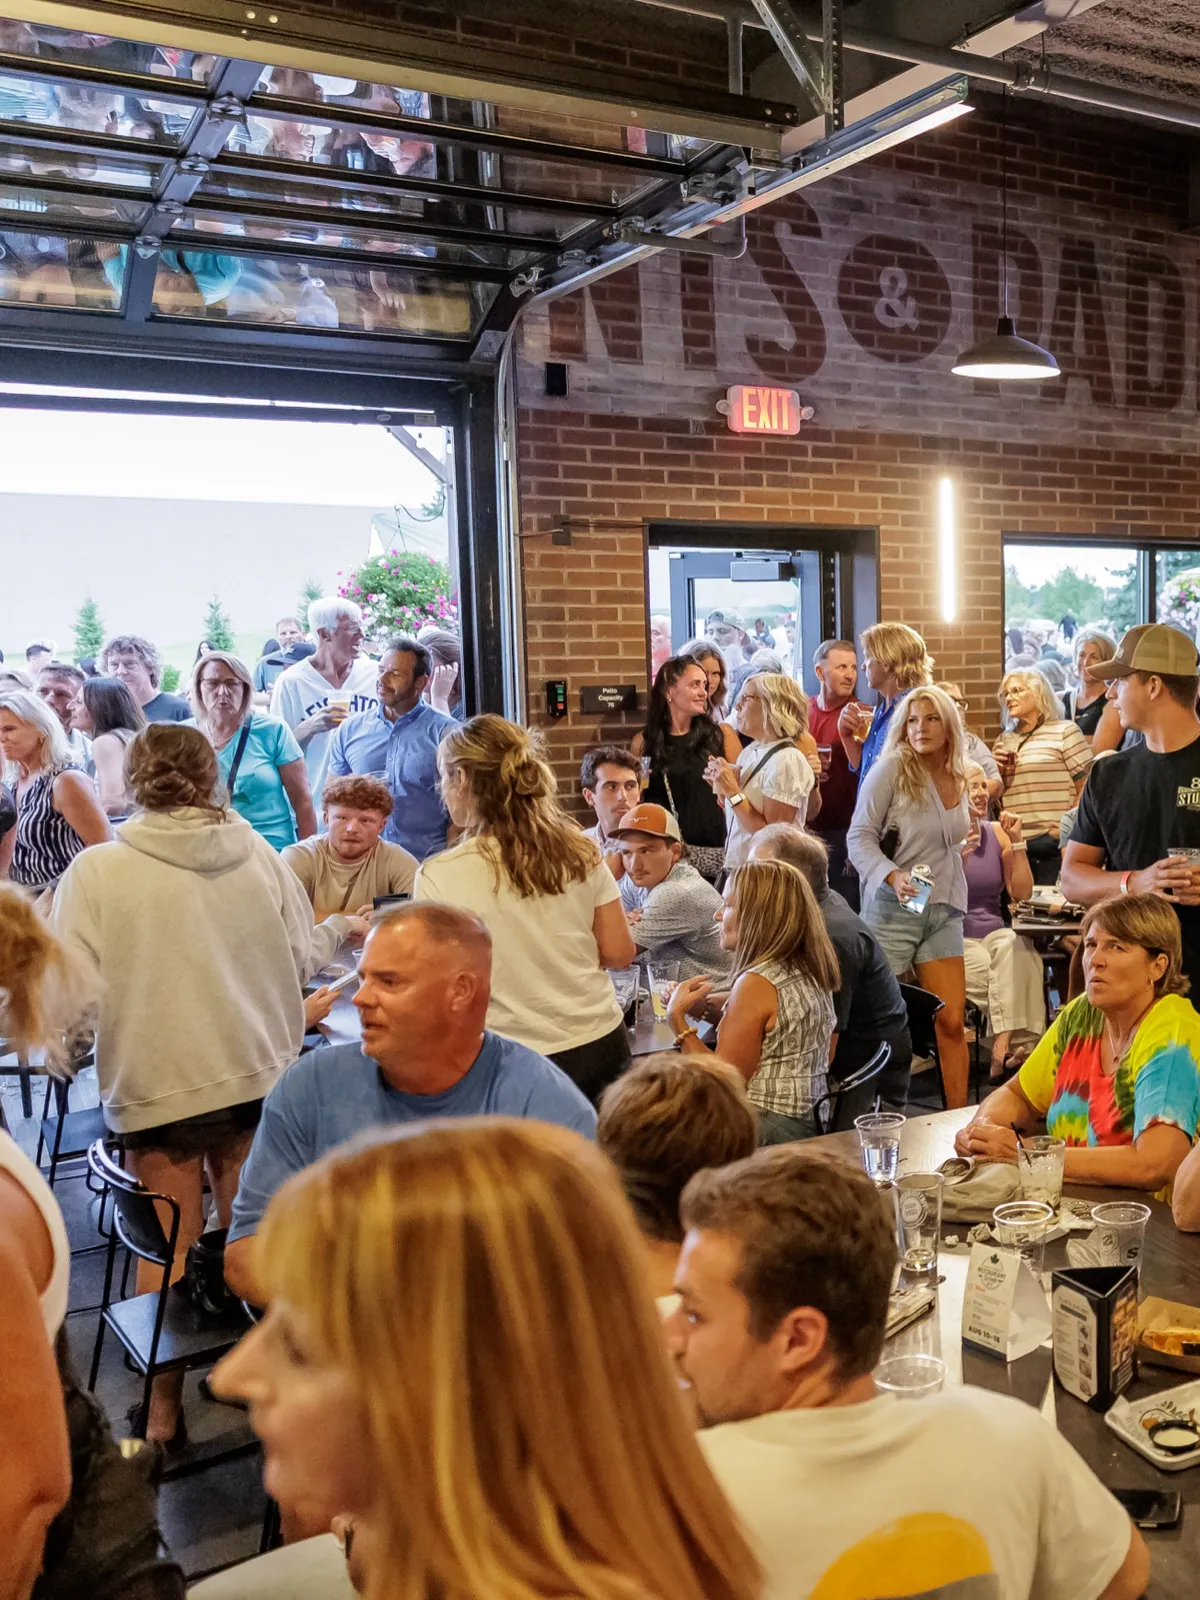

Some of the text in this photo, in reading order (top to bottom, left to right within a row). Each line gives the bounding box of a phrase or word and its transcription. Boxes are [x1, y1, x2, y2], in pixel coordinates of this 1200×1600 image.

[742, 387, 792, 431] EXIT
[598, 694, 624, 702] Capacity
[968, 1324, 982, 1336] AUG
